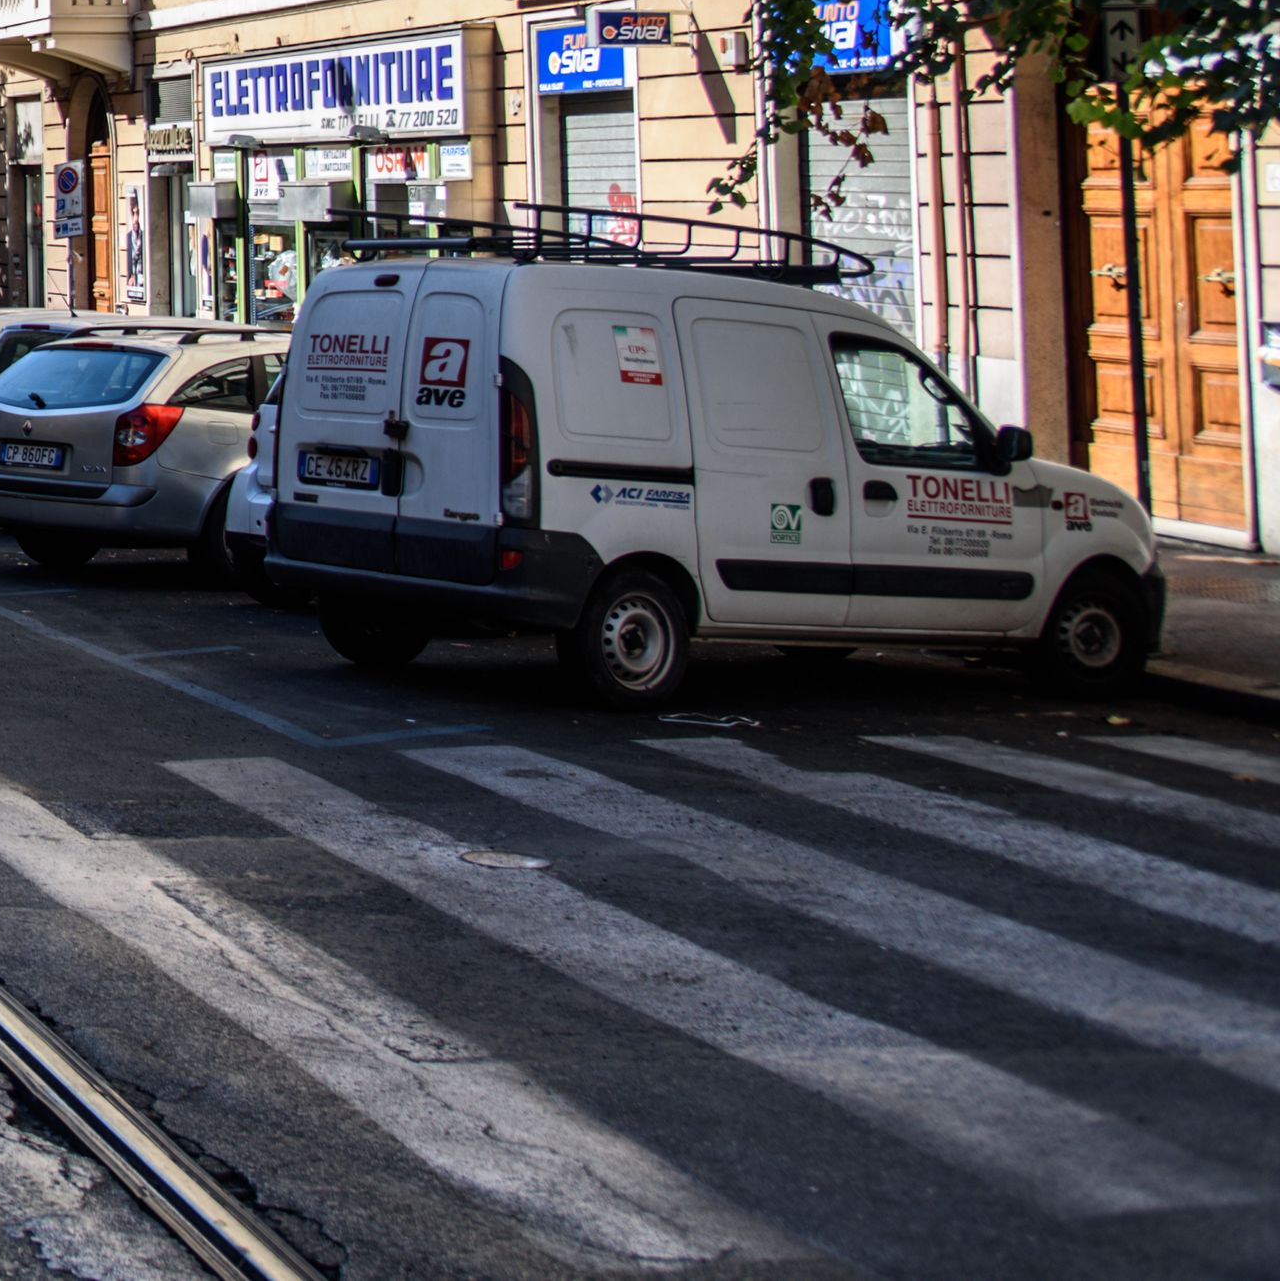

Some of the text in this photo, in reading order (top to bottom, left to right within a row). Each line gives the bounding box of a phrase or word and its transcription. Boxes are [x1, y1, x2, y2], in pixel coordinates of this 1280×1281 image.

[814, 1, 859, 21] UNTO
[621, 16, 667, 27] PUNTO
[210, 43, 454, 118] ELETTROFORNITURE
[398, 111, 412, 128] 77
[413, 110, 434, 127] 200
[436, 108, 458, 126] 520
[375, 145, 425, 173] OSRAM
[310, 334, 390, 355] TONELLI
[307, 354, 388, 367] ELETTROFORNITURE
[416, 386, 466, 408] ave
[615, 487, 691, 500] ACI FARFISA
[906, 474, 1010, 505] TONELLI
[907, 500, 1012, 519] ELETTROFORNITURE
[1066, 521, 1091, 533] ave
